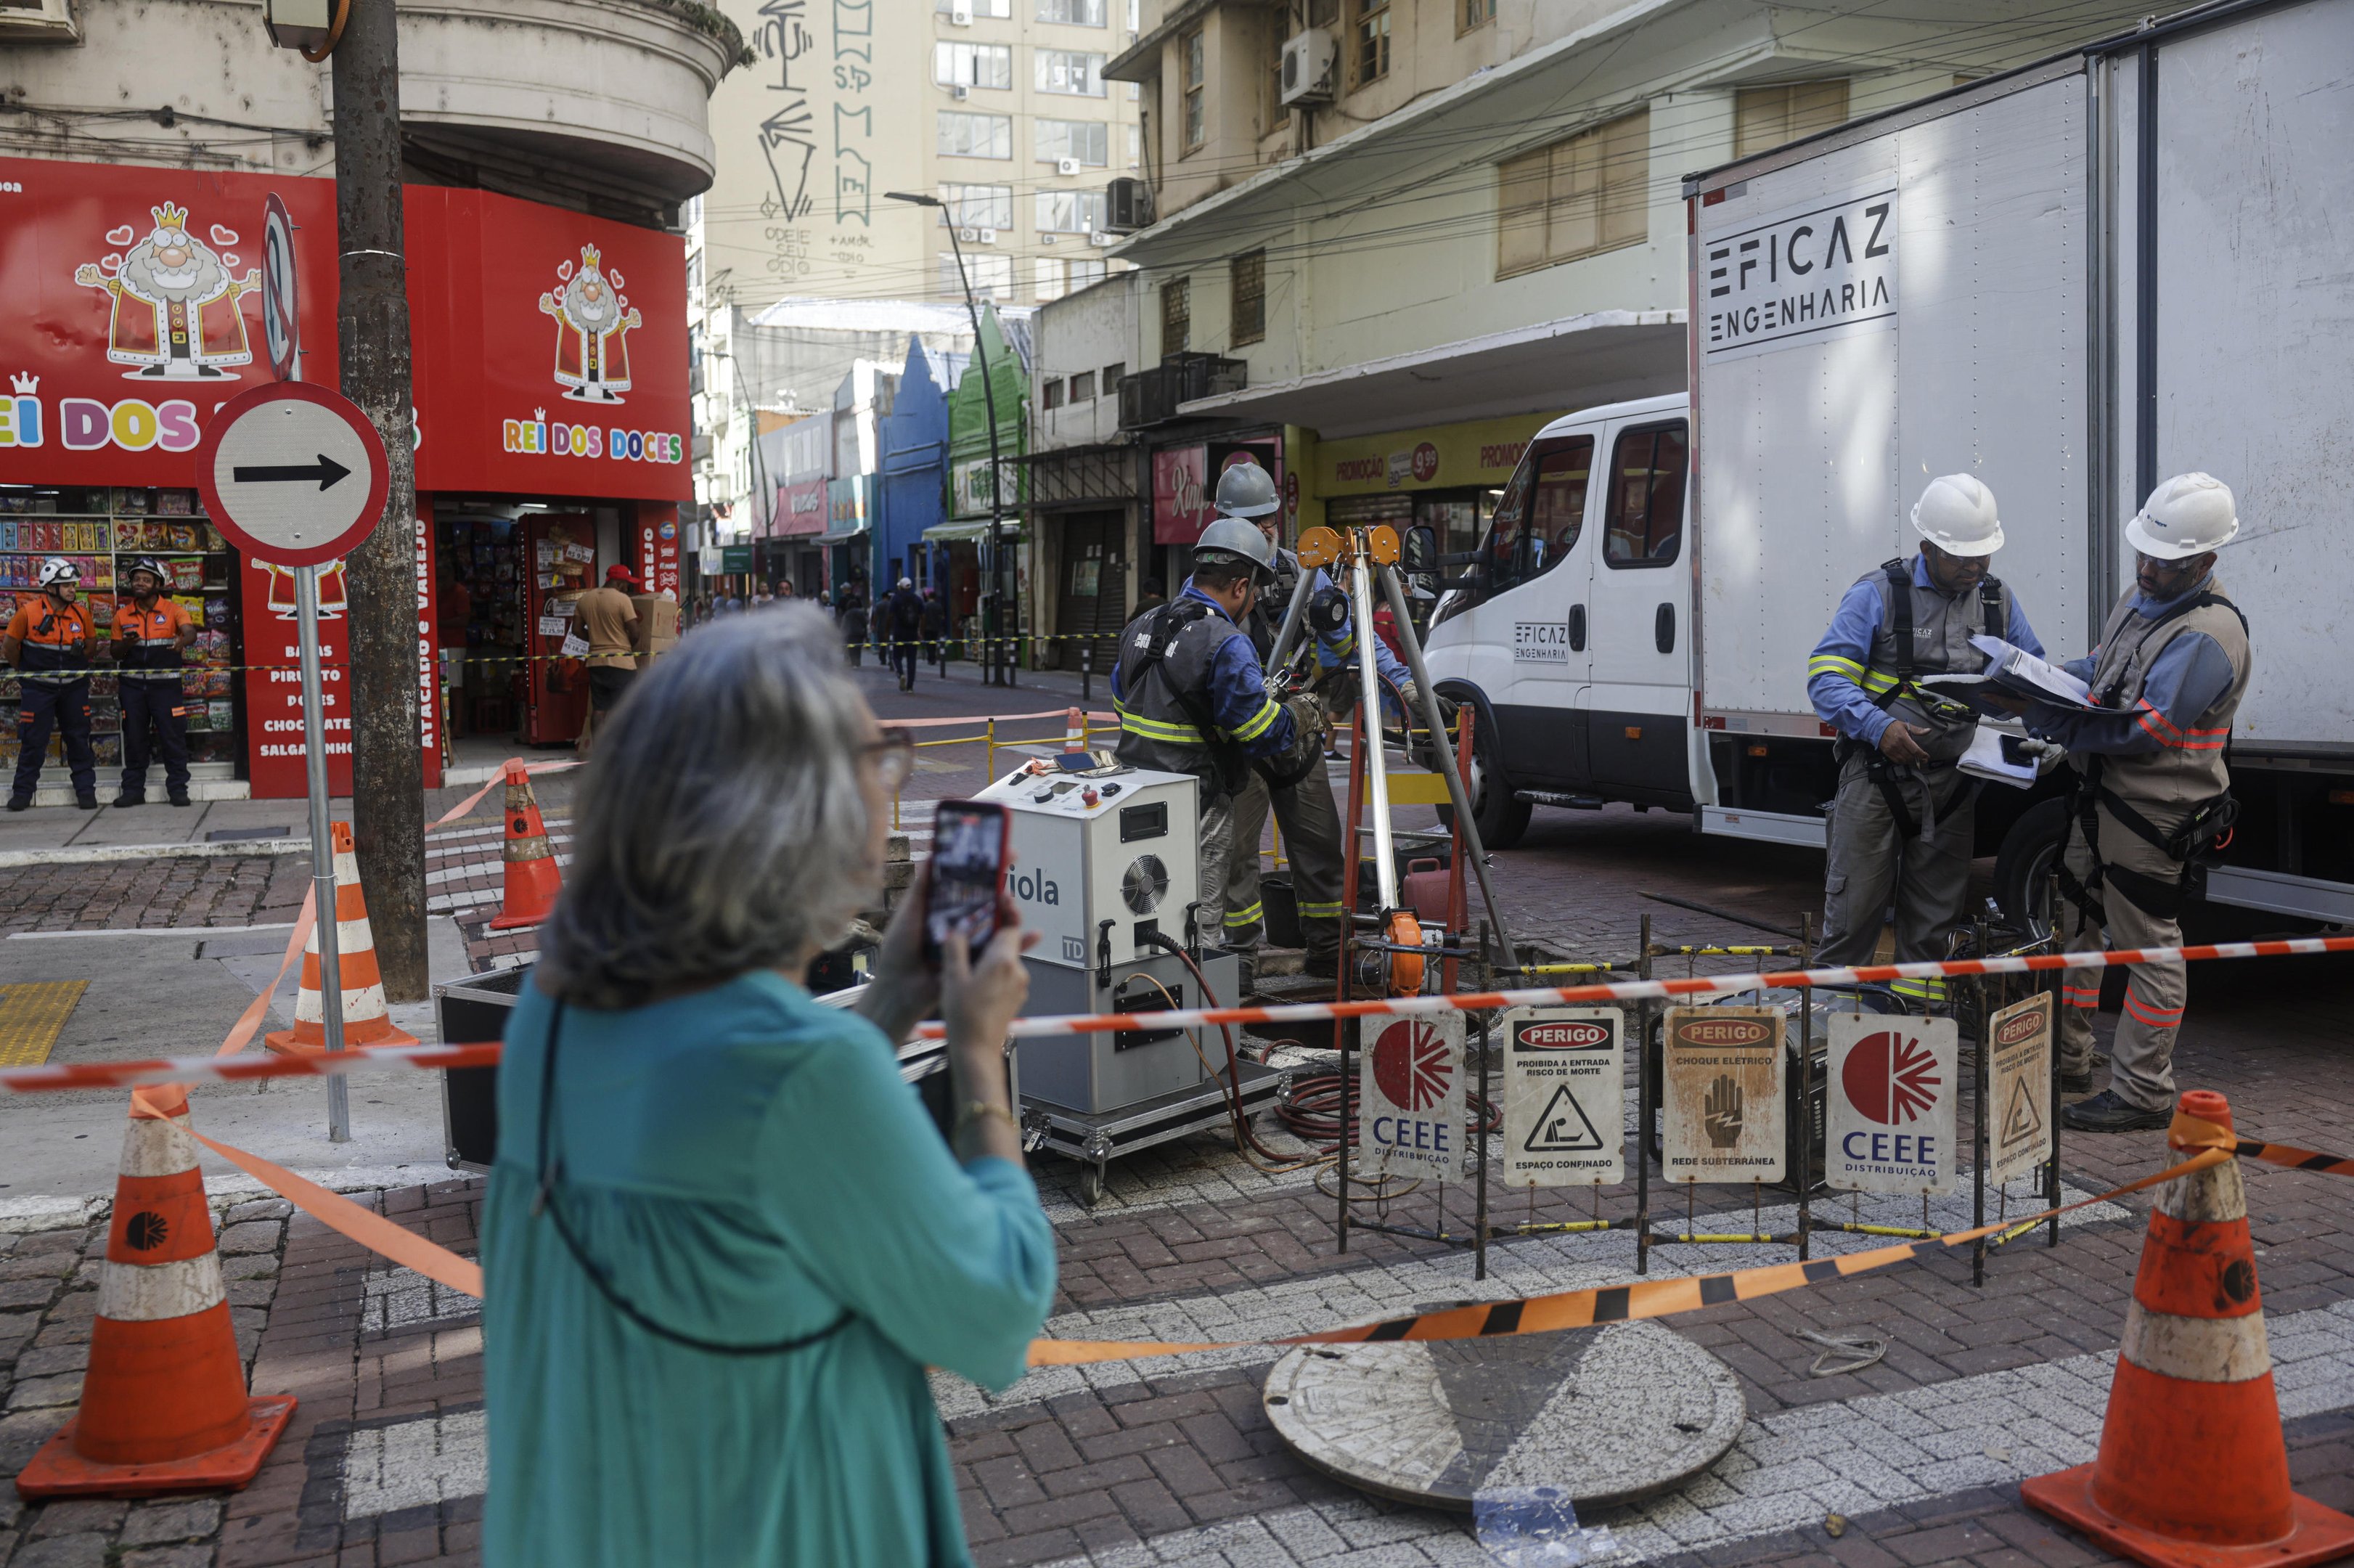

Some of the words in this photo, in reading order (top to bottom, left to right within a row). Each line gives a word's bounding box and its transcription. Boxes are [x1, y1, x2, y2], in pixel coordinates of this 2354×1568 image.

[0, 181, 23, 193] oa
[1711, 202, 1889, 298] EFICAZ
[1711, 276, 1889, 342] ENGENHARIA
[60, 397, 201, 452] DOS
[504, 419, 547, 454] REI
[552, 422, 603, 459] DOS
[610, 428, 684, 465] DOCES
[1336, 454, 1384, 484] PROMOÇÃO
[1415, 450, 1436, 476] 9,99
[416, 520, 428, 609] VAREJO
[644, 528, 655, 592] AREJO
[1516, 626, 1566, 644] EFICAZ
[1516, 648, 1566, 660] ENGENHARIA
[270, 669, 341, 682] PIRTO
[419, 639, 433, 748] ATACADO
[263, 718, 351, 732] CHOCATE
[260, 743, 353, 756] SALGANH
[1063, 939, 1084, 960] TD
[1531, 1028, 1599, 1043] PERIGO
[1691, 1026, 1760, 1040] PERIGO
[2003, 1015, 2040, 1041] PERIGO
[1676, 1057, 1719, 1066] CHOQUE
[1722, 1054, 1773, 1066] ELÉTRICO
[1995, 1053, 2019, 1069] PROIBIDA
[2024, 1042, 2045, 1056] ENTRADA
[2001, 1063, 2016, 1074] RISCO
[2024, 1052, 2040, 1064] MORTE
[1373, 1116, 1450, 1153] CEEE
[1375, 1148, 1450, 1164] DISTRIBUIÇÃO
[1842, 1131, 1936, 1165] CEEE
[1997, 1153, 2016, 1168] ESPAÇO
[2018, 1138, 2046, 1157] CONFINADO
[1516, 1161, 1553, 1171] ESPAÇO
[1556, 1159, 1612, 1169] CONFINADO
[1672, 1157, 1699, 1166] REDE
[1701, 1155, 1775, 1166] SUBTERRÂNEA
[1845, 1164, 1937, 1177] DISTRIBUIÇÃO
